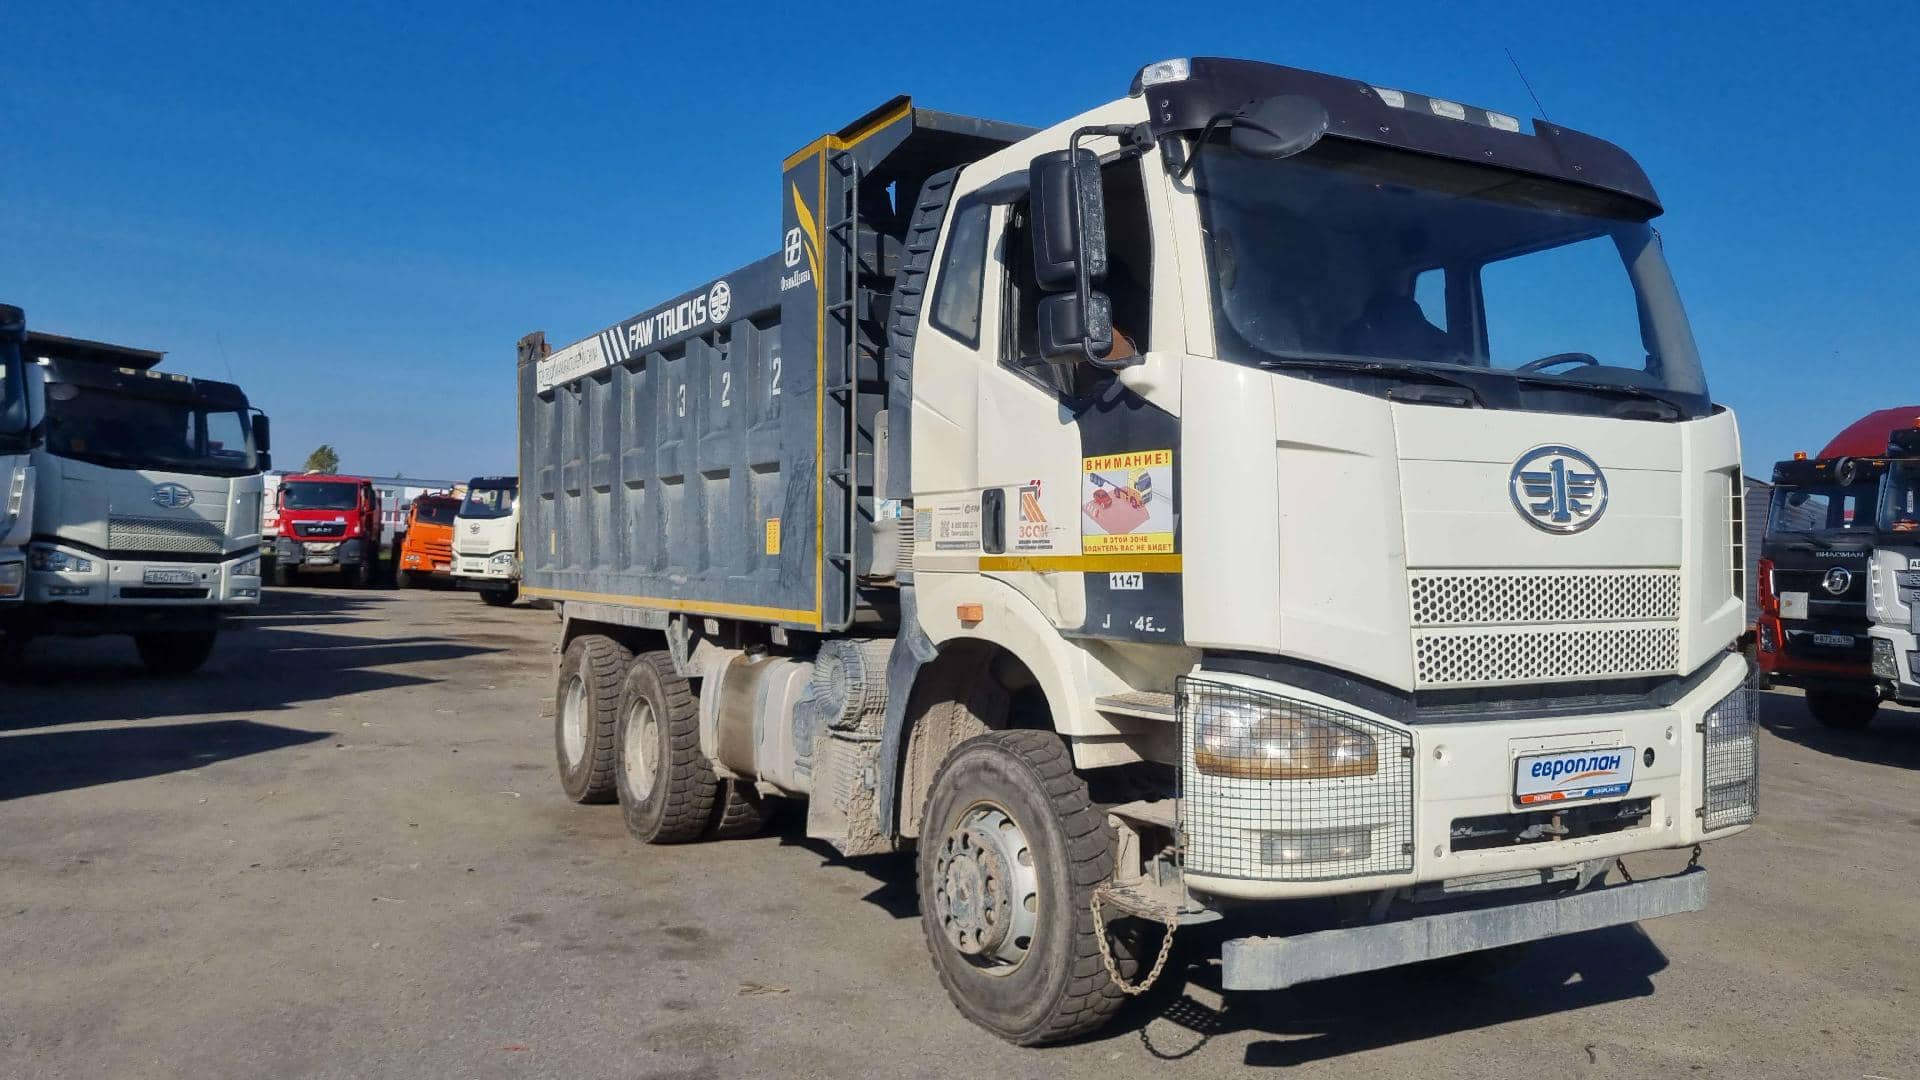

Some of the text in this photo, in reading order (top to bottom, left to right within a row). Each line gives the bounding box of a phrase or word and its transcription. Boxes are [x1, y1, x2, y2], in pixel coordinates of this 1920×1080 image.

[628, 294, 707, 352] FAW TRUCKS
[679, 357, 782, 418] 3 2 2
[1086, 452, 1169, 471] ВНИМАНИЕ!
[1120, 544, 1134, 552] ВАС
[1147, 543, 1171, 551] ВИДЕТ
[1111, 574, 1140, 588] 1147
[1531, 755, 1621, 781] европлан
